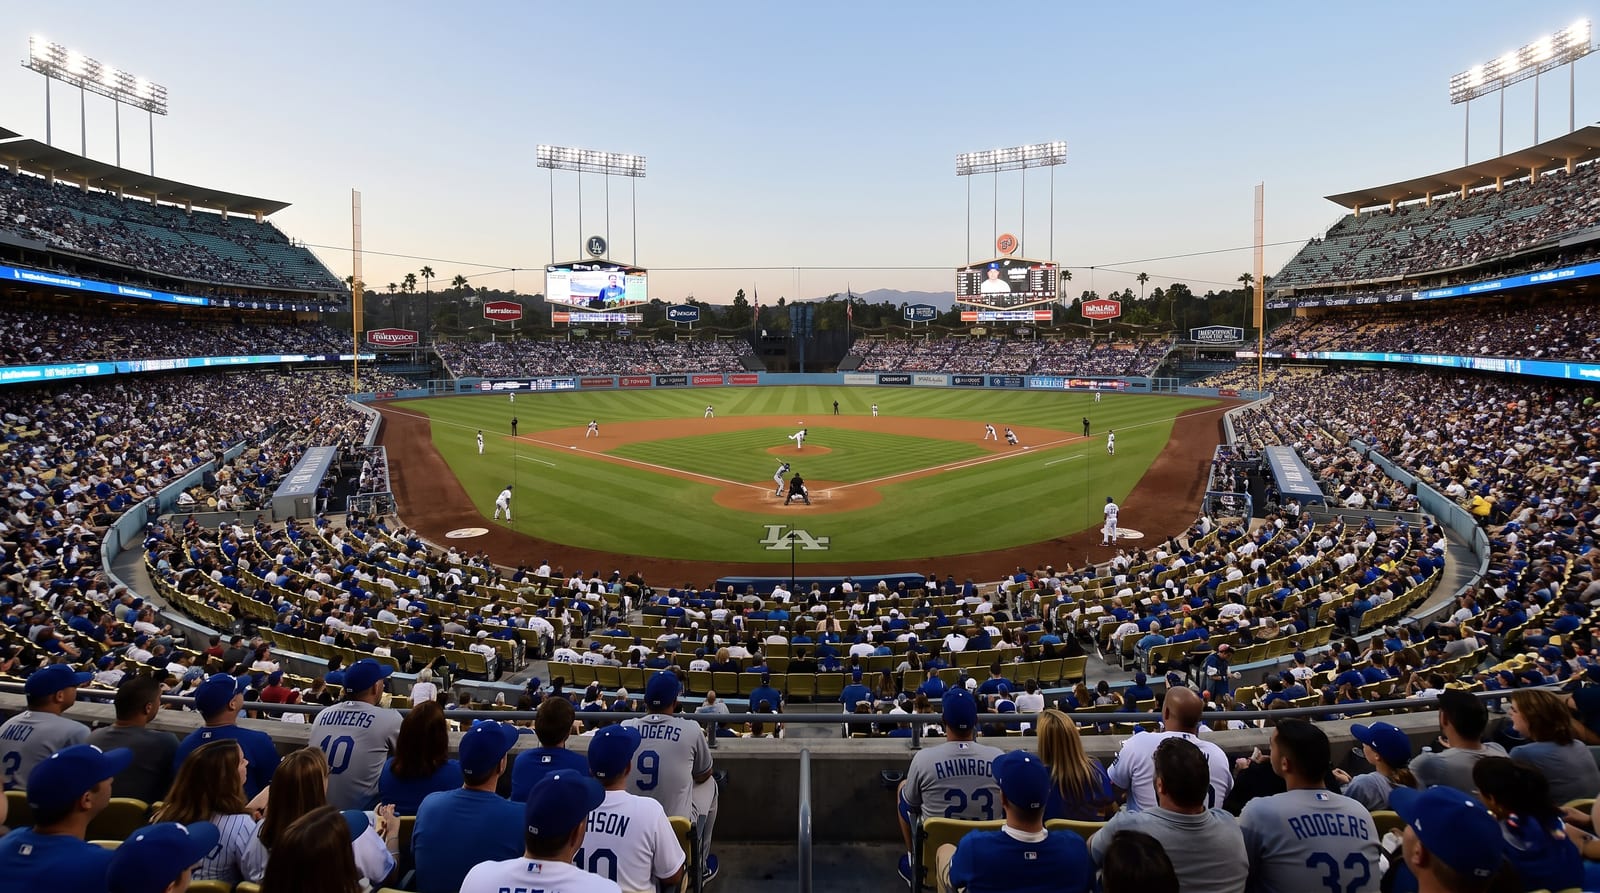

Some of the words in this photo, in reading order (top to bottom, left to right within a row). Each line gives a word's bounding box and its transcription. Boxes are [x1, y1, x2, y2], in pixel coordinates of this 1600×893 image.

[591, 238, 602, 254] LA
[759, 524, 830, 550] LA
[636, 750, 660, 791] 9
[943, 788, 994, 821] 23
[1305, 852, 1371, 893] 32
